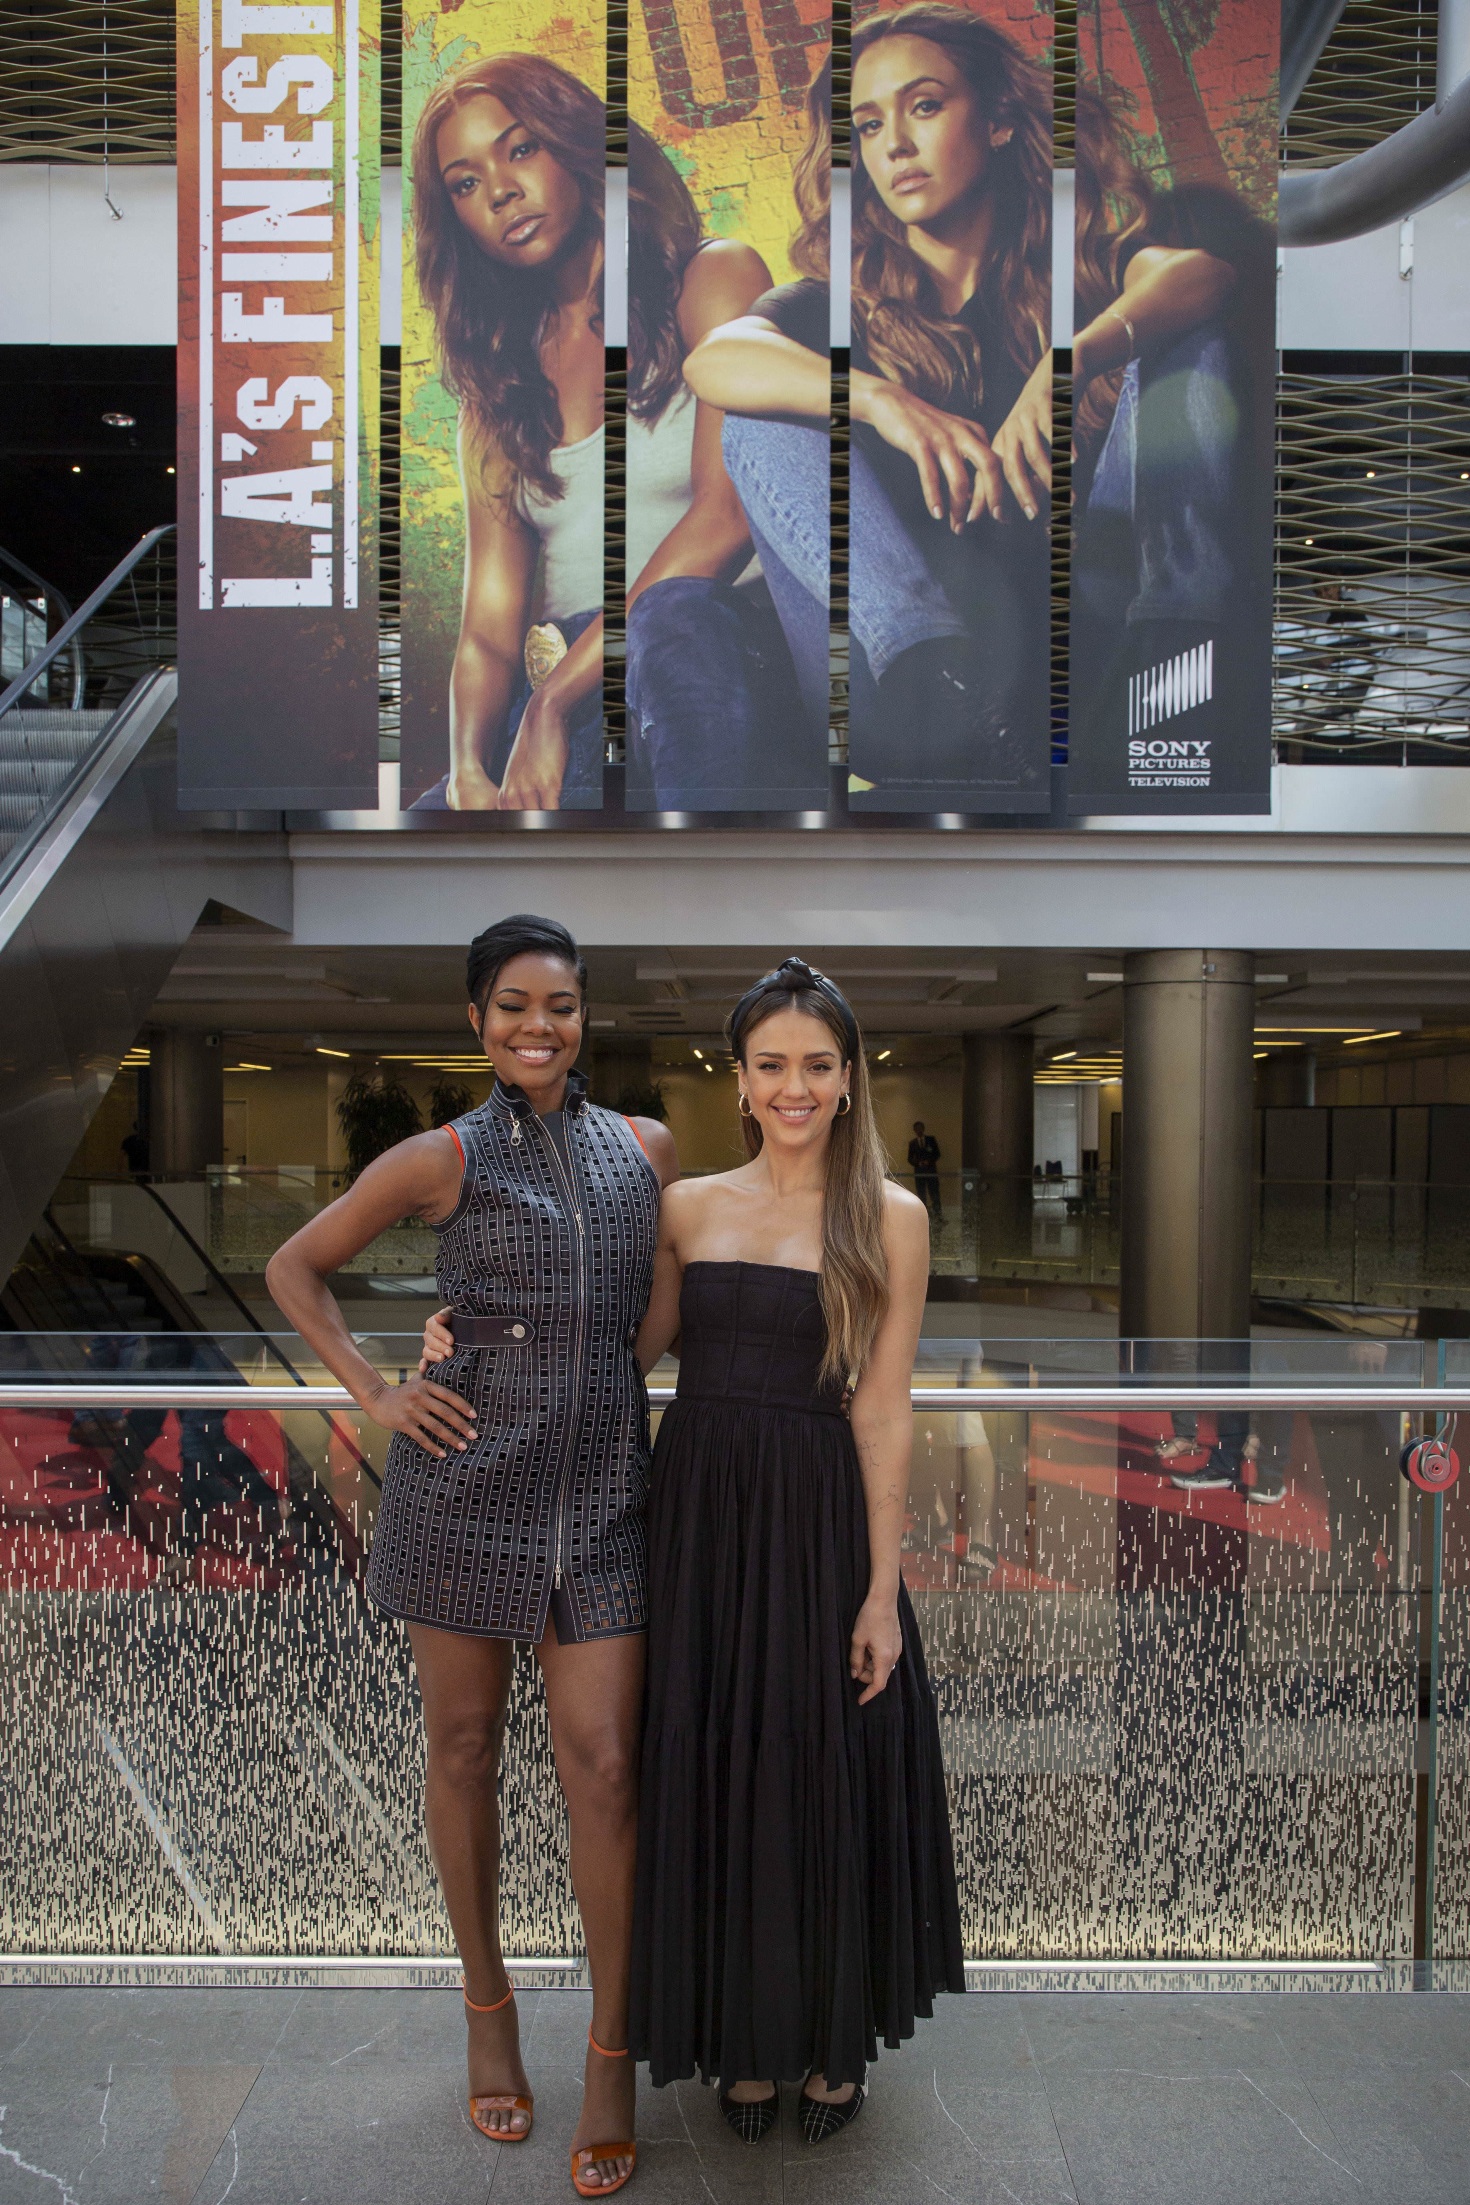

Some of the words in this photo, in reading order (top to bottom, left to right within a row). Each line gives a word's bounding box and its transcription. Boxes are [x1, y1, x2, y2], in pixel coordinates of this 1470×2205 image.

[221, 0, 334, 342] FINEST
[1128, 740, 1211, 757] SONY
[1128, 758, 1211, 769] PICTURES
[1128, 777, 1211, 787] TELEVISION
